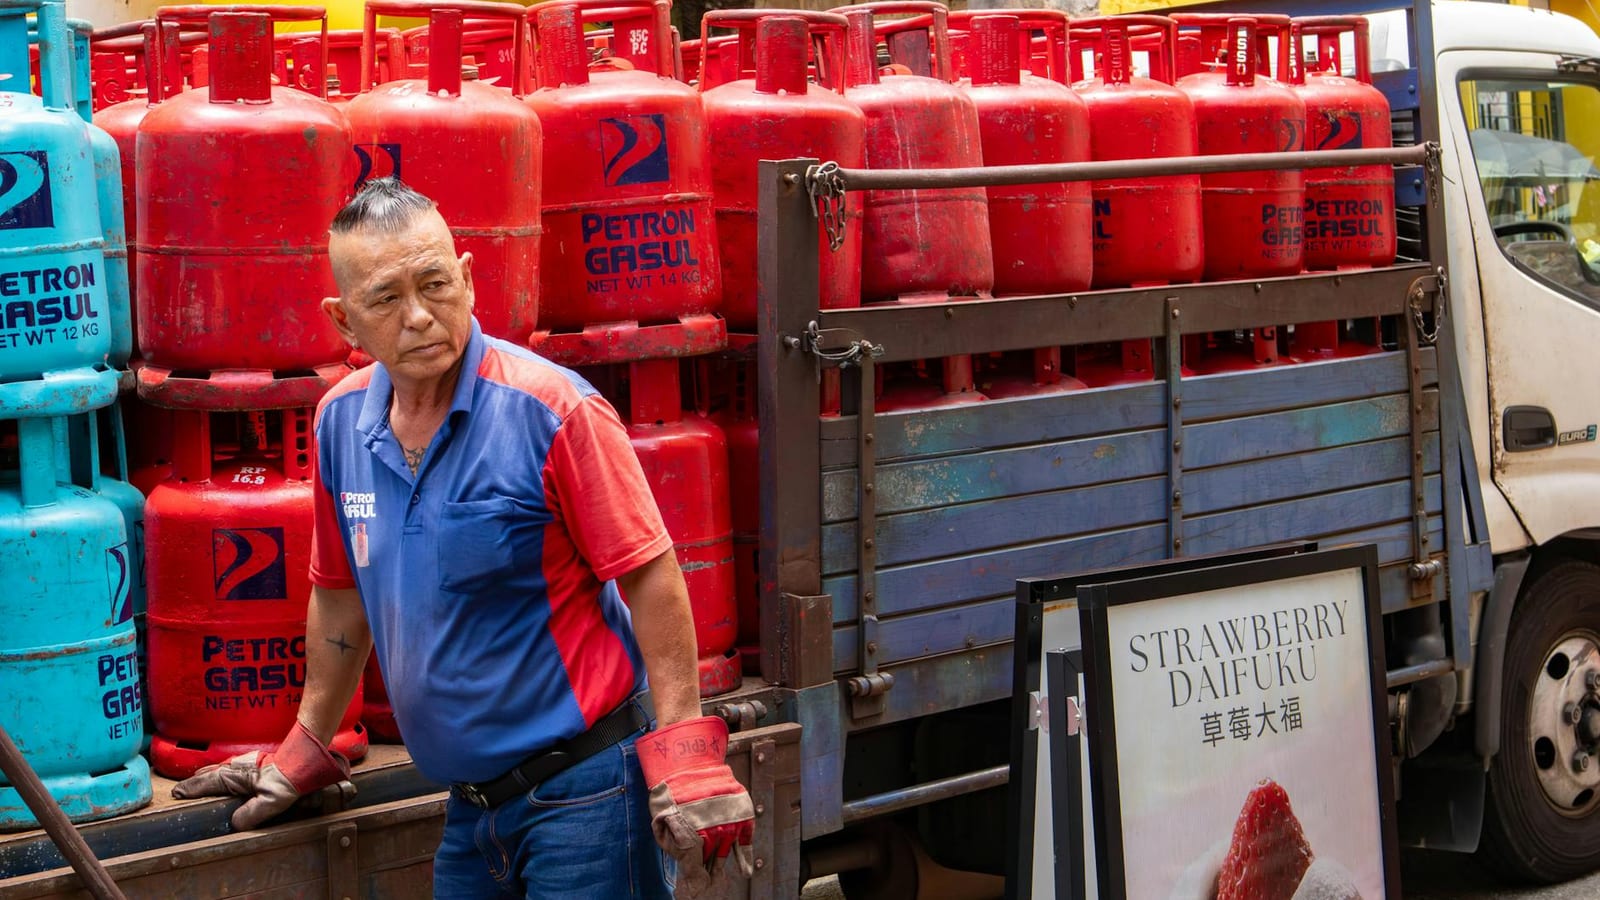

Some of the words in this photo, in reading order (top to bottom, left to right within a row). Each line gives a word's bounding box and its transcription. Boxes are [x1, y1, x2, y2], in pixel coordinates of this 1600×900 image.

[629, 29, 648, 42] 35C
[1303, 198, 1383, 216] PETRON
[582, 209, 695, 243] PETRON
[1303, 219, 1384, 238] GASUL
[585, 240, 698, 275] GASUL
[587, 279, 619, 293] NET
[626, 275, 652, 289] WT
[660, 273, 677, 286] 14
[682, 270, 700, 284] KG
[0, 293, 98, 329] ASUL
[25, 329, 56, 346] WT
[62, 326, 78, 340] 12
[82, 323, 99, 337] KG
[232, 473, 265, 485] 16.8
[240, 466, 267, 474] RP
[203, 635, 306, 662] PETRO
[1129, 600, 1348, 673] STRAWBERRY
[205, 664, 306, 692] GASU
[1168, 645, 1317, 708] DAIFUKU
[102, 681, 141, 719] GAS
[206, 695, 243, 710] NET
[247, 694, 278, 709] WT
[1200, 697, 1303, 748] 草莓大福
[677, 739, 707, 756] EPIC
